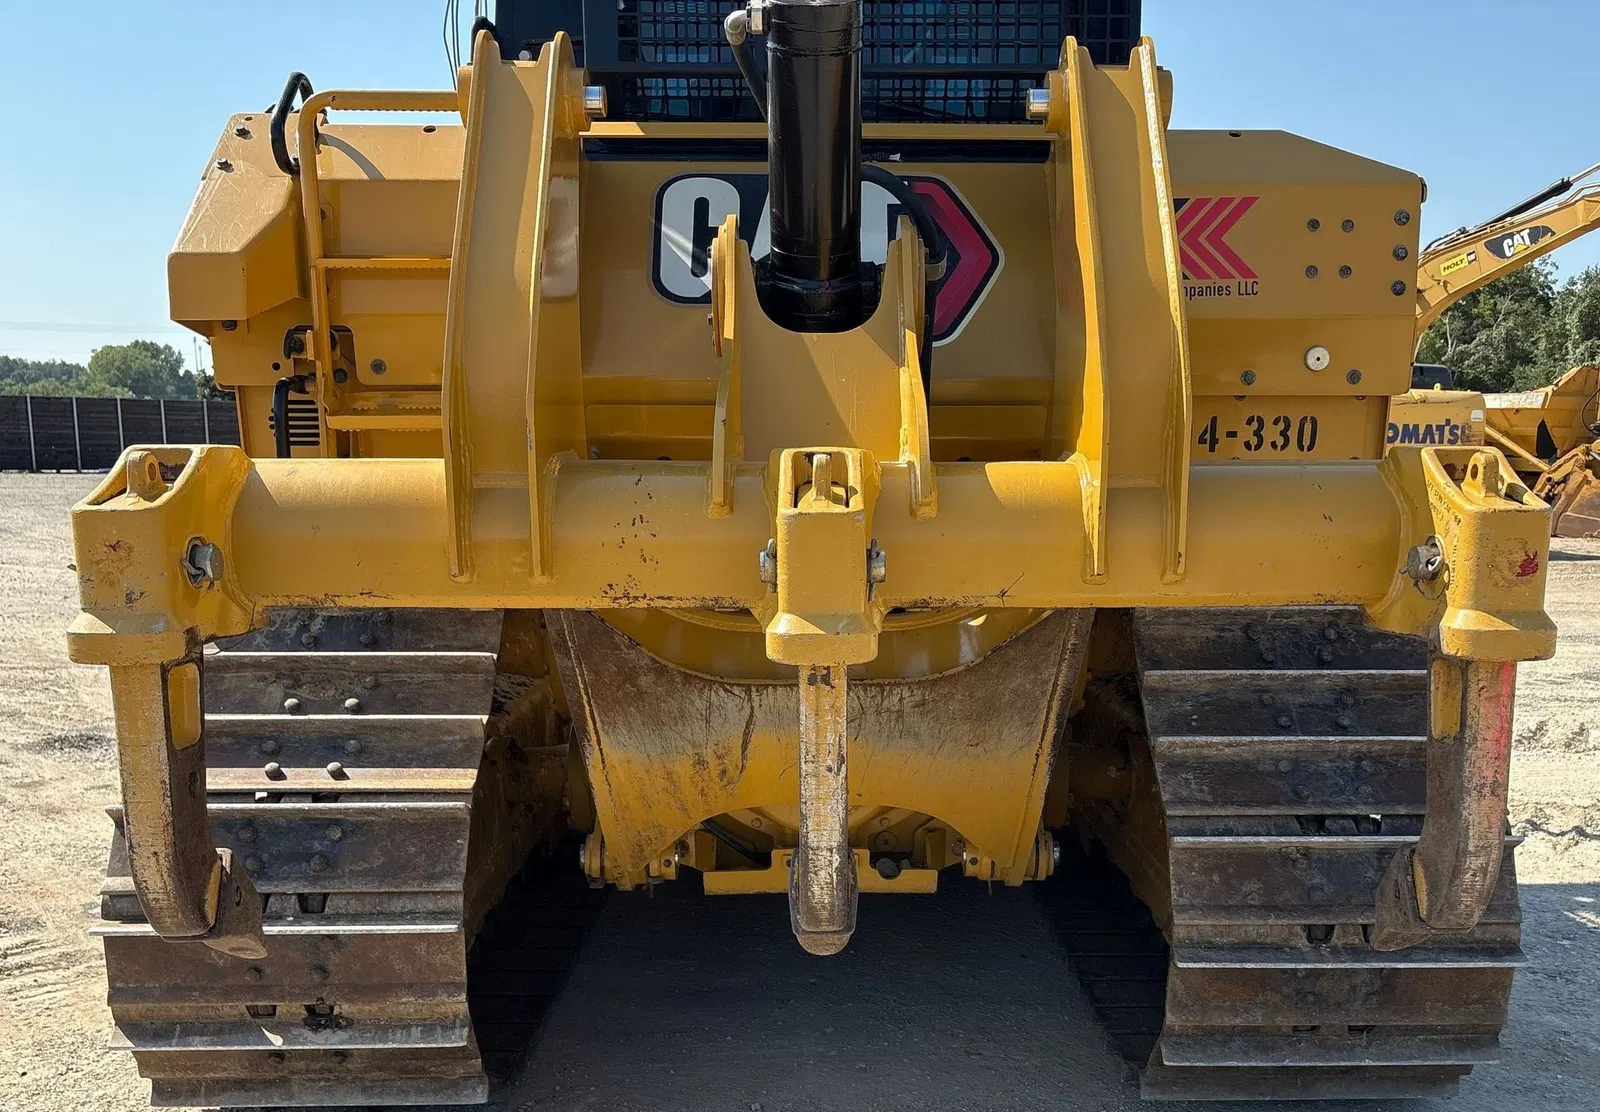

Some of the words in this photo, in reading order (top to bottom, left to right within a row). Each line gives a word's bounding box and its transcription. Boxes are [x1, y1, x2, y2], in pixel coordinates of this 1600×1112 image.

[1503, 228, 1531, 257] CAT
[1443, 258, 1465, 272] HOLT
[1238, 281, 1259, 296] LLC
[1197, 415, 1318, 453] 4-330
